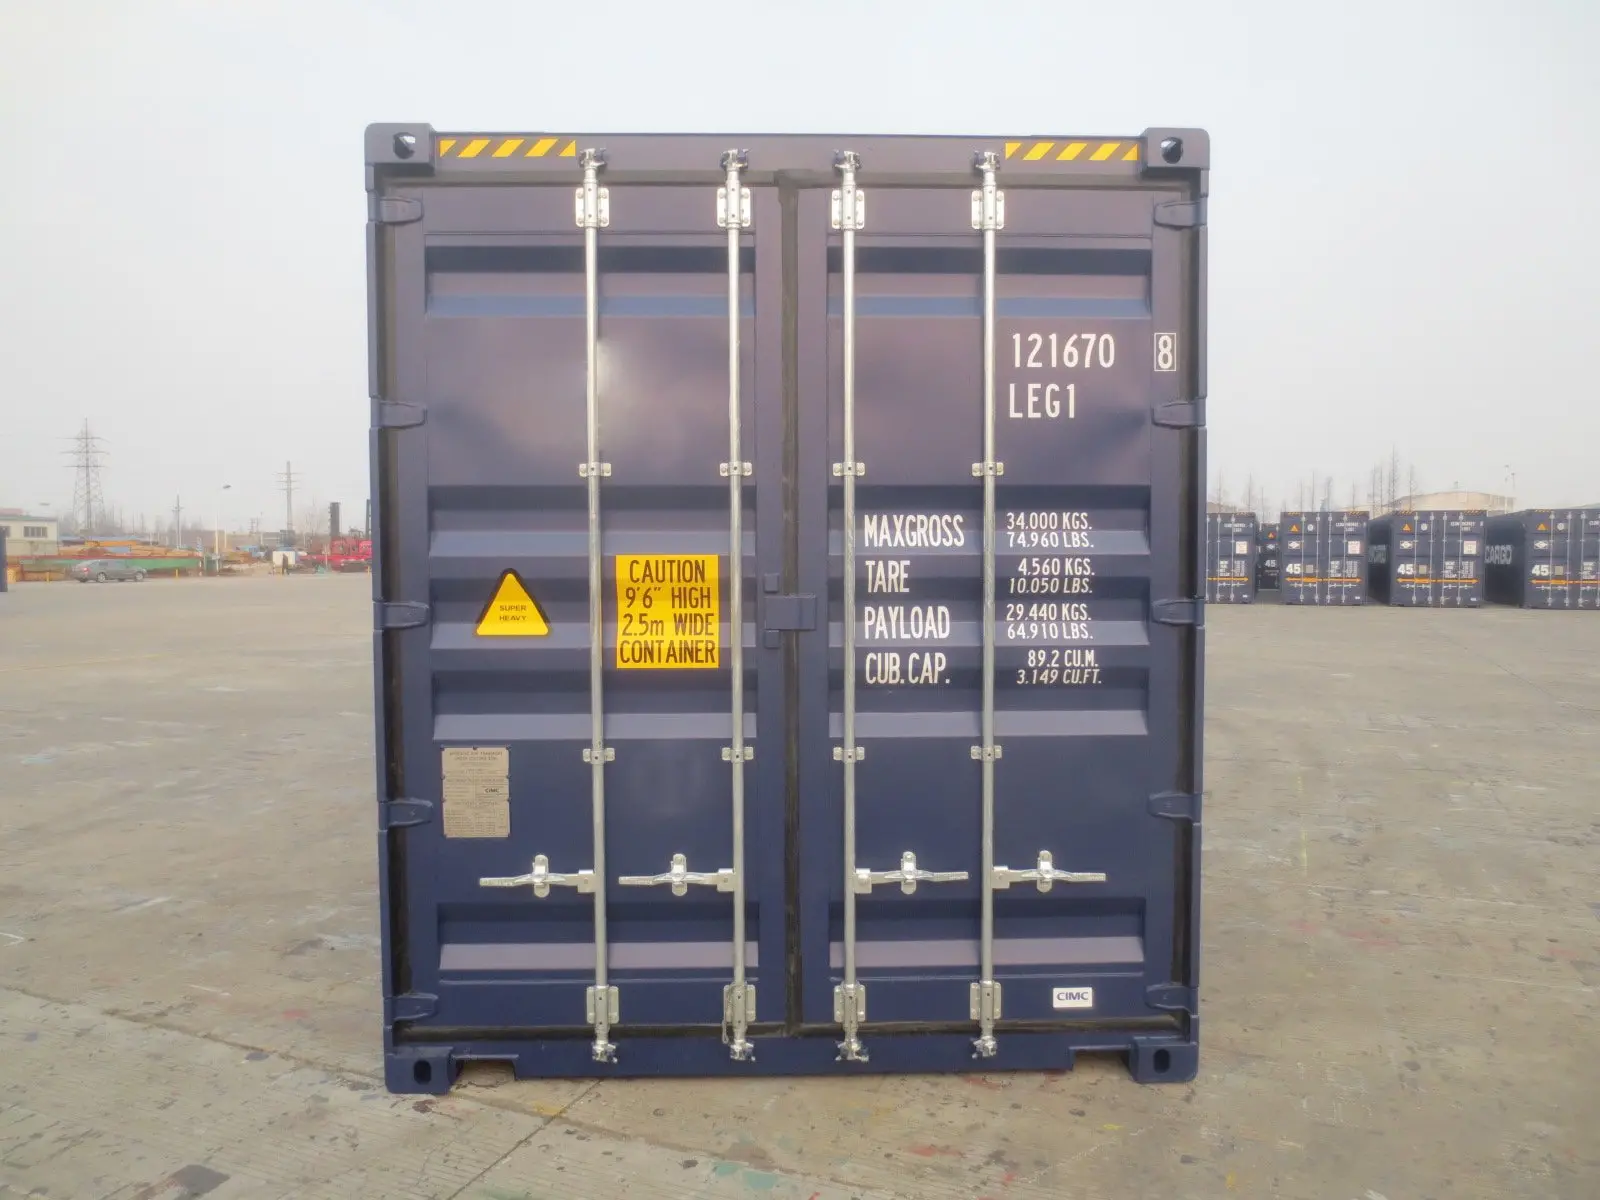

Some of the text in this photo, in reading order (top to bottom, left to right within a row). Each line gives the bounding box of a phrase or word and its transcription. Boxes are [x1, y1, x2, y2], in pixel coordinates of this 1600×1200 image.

[1012, 333, 1173, 370] 121670 8
[1009, 383, 1075, 419] LEG1
[1062, 511, 1093, 530] KGS.
[864, 514, 965, 548] MAXGROSS
[1062, 531, 1094, 548] LBS.
[1264, 559, 1277, 568] 45
[1484, 545, 1513, 565] CARGO
[629, 559, 706, 584] CAUTION
[865, 559, 911, 593] TARE
[1064, 557, 1095, 576] KGS.
[1286, 563, 1302, 575] 45
[1397, 563, 1414, 575] 45
[1532, 564, 1550, 576] 45
[1063, 577, 1093, 594] LBS.
[671, 586, 711, 609] HIGH
[499, 604, 527, 612] SUPER
[1061, 602, 1092, 621] KGS.
[499, 614, 527, 622] HEAVY
[622, 612, 715, 637] 2.5m WIDE
[864, 605, 950, 640] PAYLOAD
[1062, 622, 1094, 640] LBS.
[619, 639, 716, 664] CONTAINER
[1027, 649, 1099, 668] 89.2 CU.M.
[1062, 668, 1102, 685] CU.FT.
[1056, 991, 1089, 1001] CIMC
